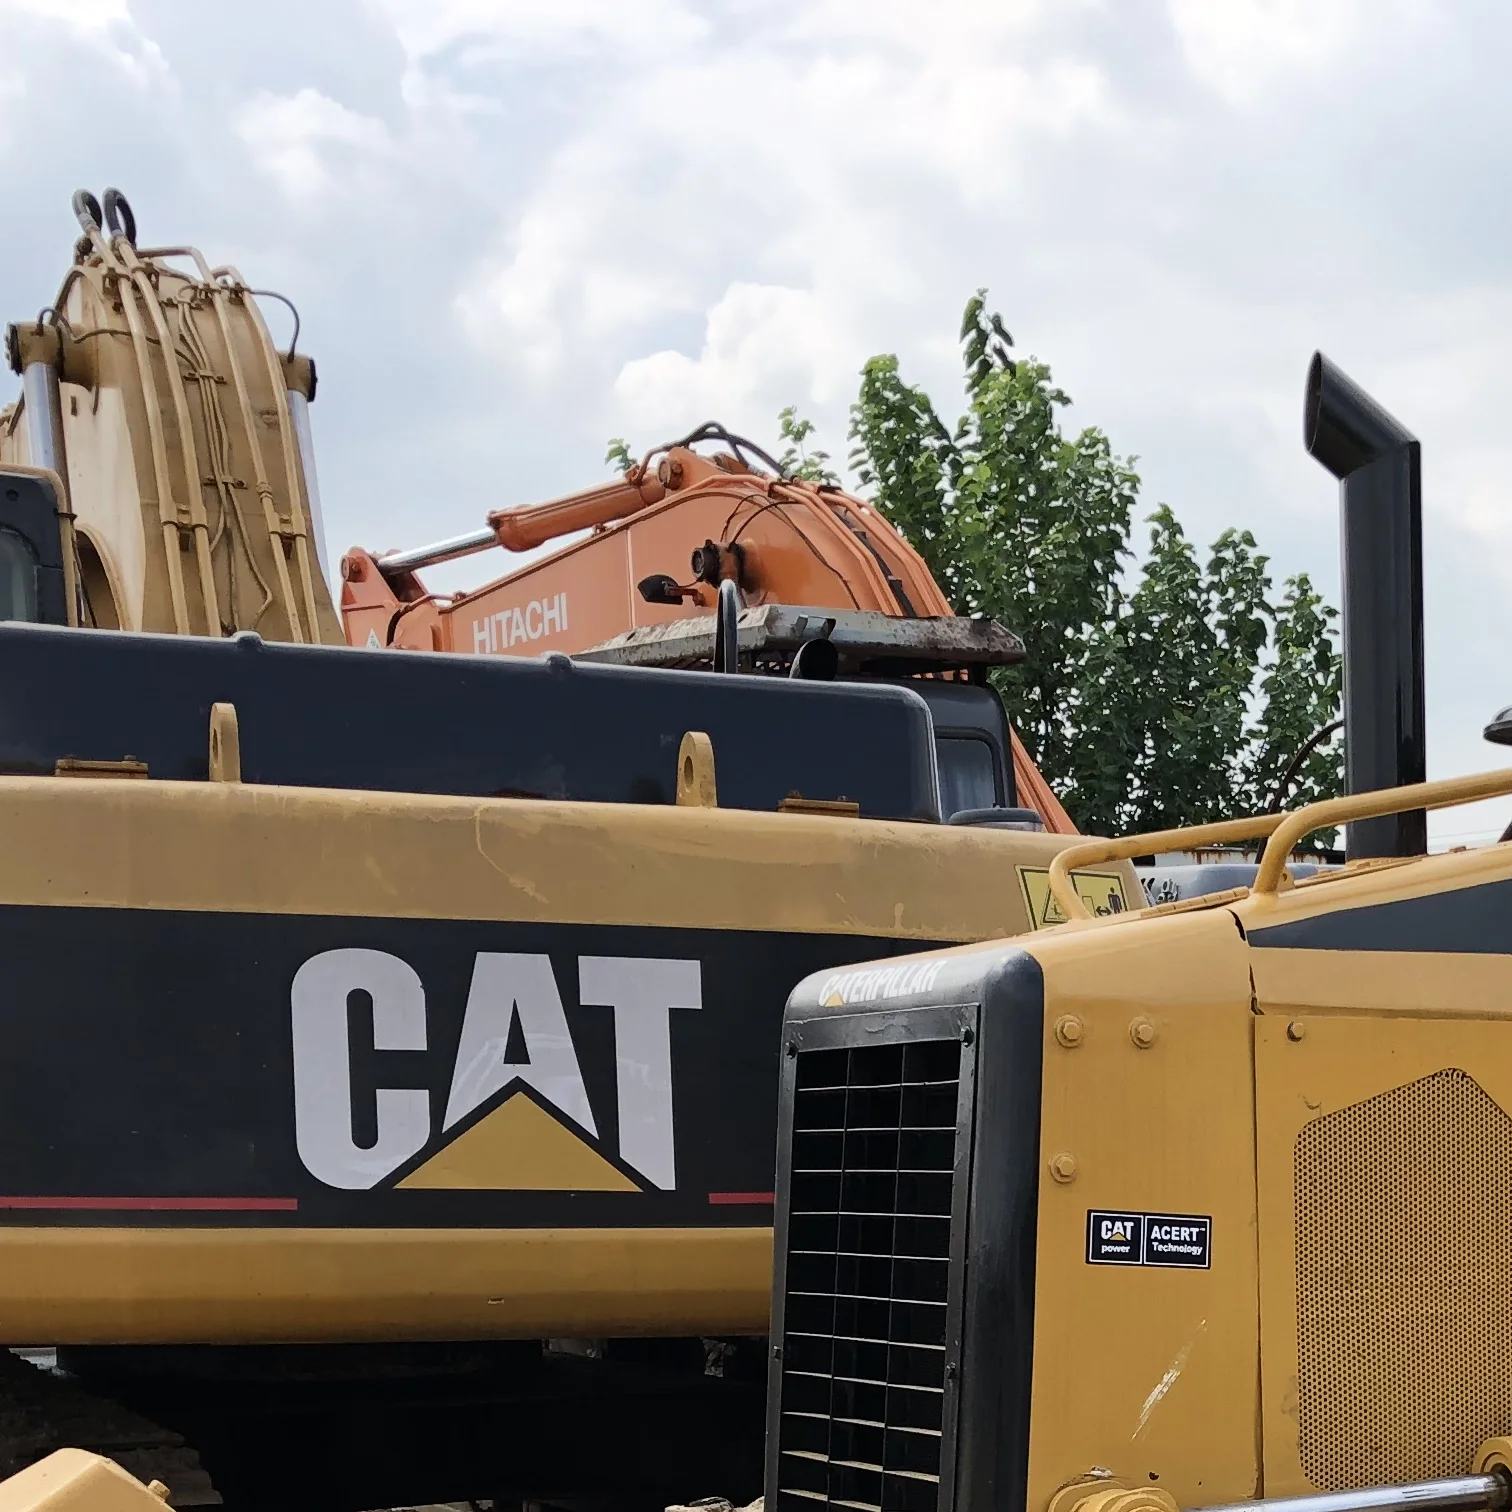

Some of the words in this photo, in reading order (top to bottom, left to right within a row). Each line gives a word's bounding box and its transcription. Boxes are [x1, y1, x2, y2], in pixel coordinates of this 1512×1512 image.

[473, 592, 568, 655] HITACHI
[818, 960, 947, 1008] CATERPILLAR
[290, 947, 703, 1191] CAT
[1100, 1220, 1135, 1241] CAT
[1101, 1243, 1131, 1254] power
[1151, 1241, 1203, 1256] Technology
